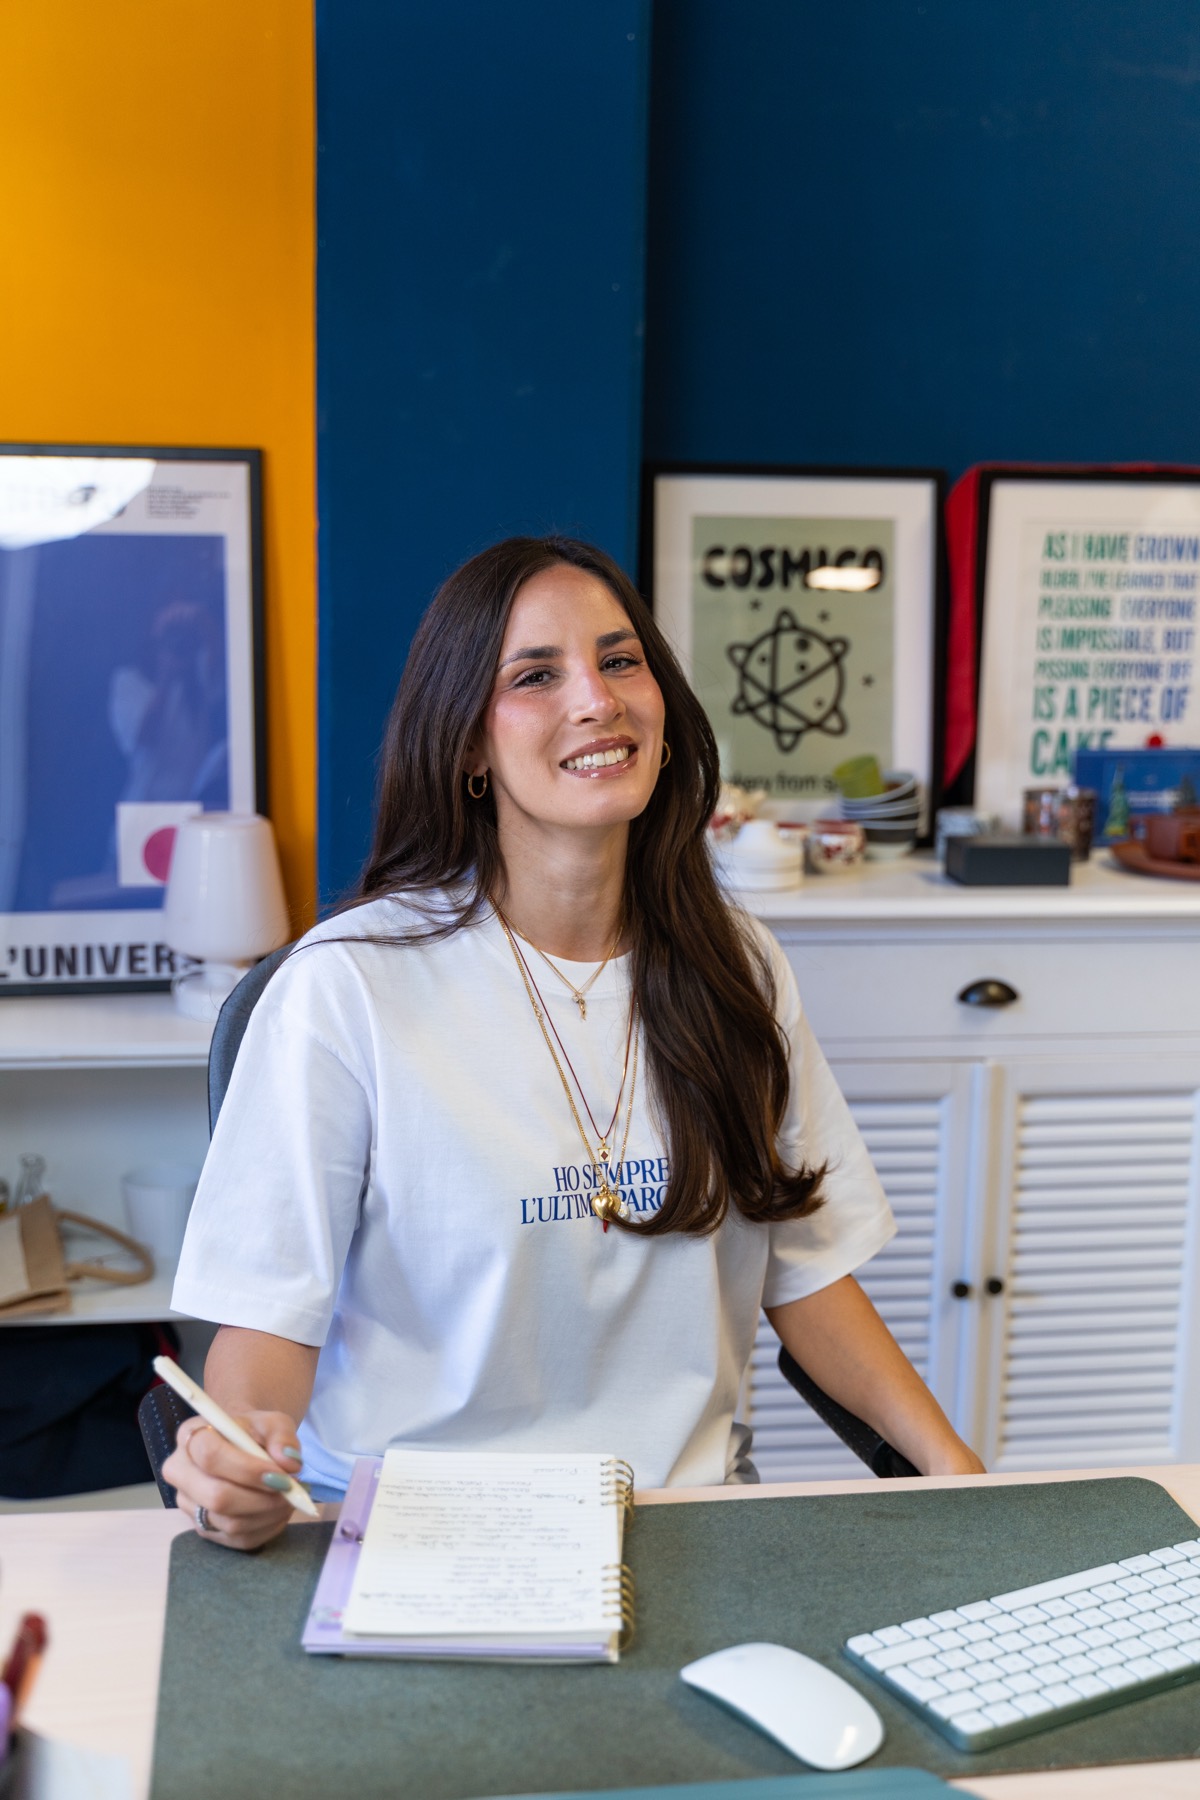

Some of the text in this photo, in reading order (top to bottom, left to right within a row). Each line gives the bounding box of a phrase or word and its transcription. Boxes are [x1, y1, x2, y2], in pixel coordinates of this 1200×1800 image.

[1042, 533, 1200, 563] AS I HAVE GROWN
[1038, 596, 1195, 620] PLEASING EVERYONE
[1036, 626, 1052, 651] IS
[1163, 627, 1195, 652] BUT
[1093, 659, 1163, 680] EVERYONE
[1033, 687, 1191, 722] IS A PIECE OF
[553, 1157, 671, 1192] HO SEMPRE
[520, 1191, 603, 1225] L'ULTIM
